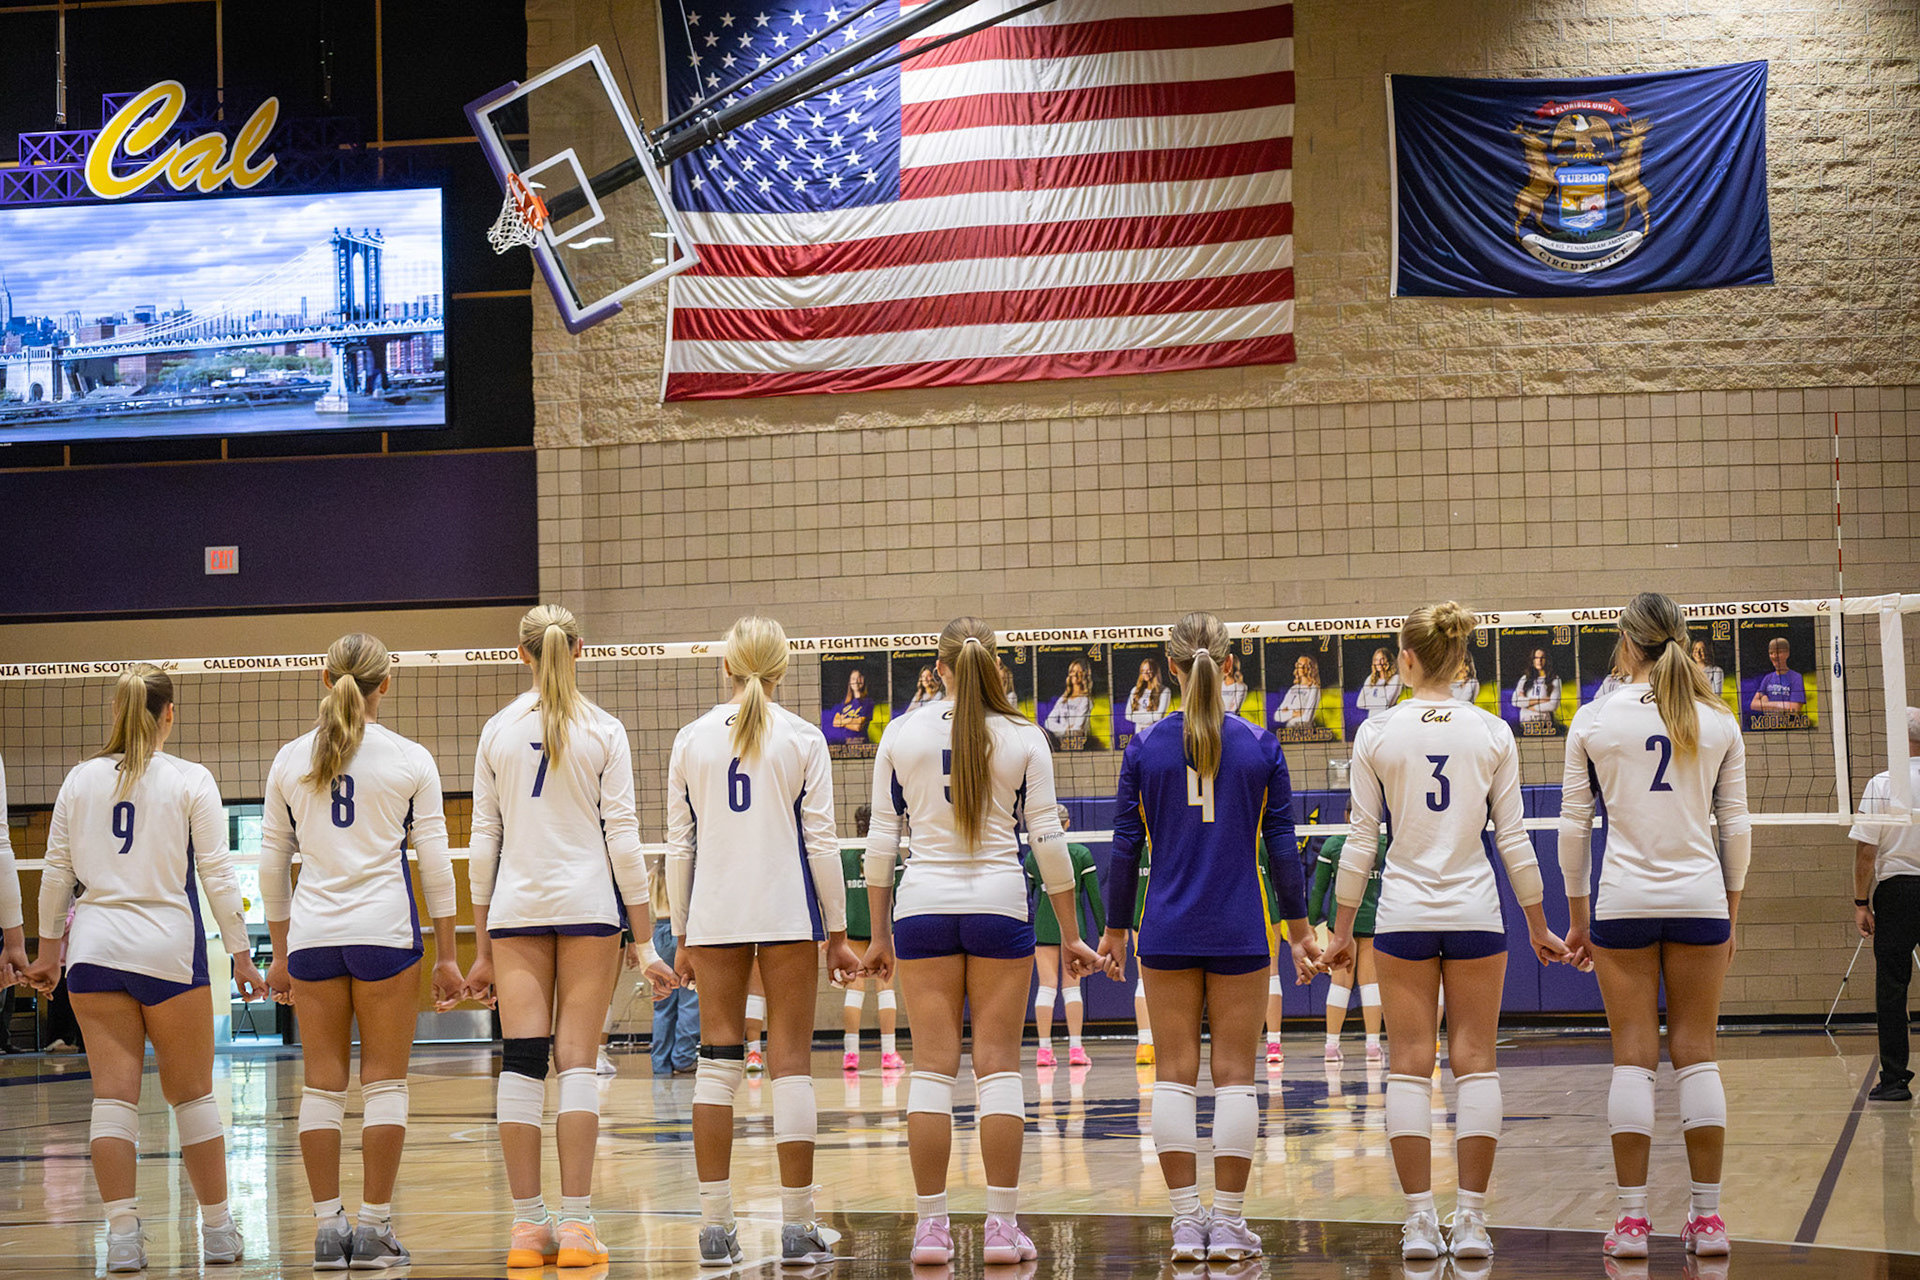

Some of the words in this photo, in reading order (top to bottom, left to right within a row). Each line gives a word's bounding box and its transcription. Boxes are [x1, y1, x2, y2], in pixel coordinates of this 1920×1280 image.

[1555, 102, 1591, 113] PLURIBUS
[1592, 103, 1615, 113] UNUM
[84, 79, 279, 200] Cal
[1559, 173, 1606, 183] TUEBOR
[210, 549, 234, 570] EXIT
[1741, 601, 1790, 614] SCOTS
[1241, 623, 1260, 634] Cal
[1287, 619, 1371, 632] CALEDONIA
[1711, 620, 1731, 641] 12
[819, 637, 889, 649] FIGHTING
[893, 635, 939, 647] SCOTS
[1006, 629, 1088, 642] CALEDONIA
[1093, 627, 1164, 639] FIGHTING
[1476, 628, 1489, 647] 9
[1552, 625, 1571, 645] 10
[621, 645, 665, 656] SCOTS
[690, 644, 709, 654] Cal
[1087, 643, 1102, 661] 4
[1241, 638, 1253, 655] 6
[24, 663, 90, 675] FIGHTING
[161, 661, 179, 671] Cal
[203, 657, 281, 669] CALEDONIA
[1421, 708, 1451, 723] Cal
[1522, 720, 1557, 736] BELL
[529, 742, 550, 798] 7
[1645, 735, 1673, 792] 2
[727, 756, 751, 813] 6
[1425, 755, 1451, 813] 3
[331, 774, 355, 828] 8
[1186, 764, 1215, 823] 4
[112, 801, 135, 854] 9
